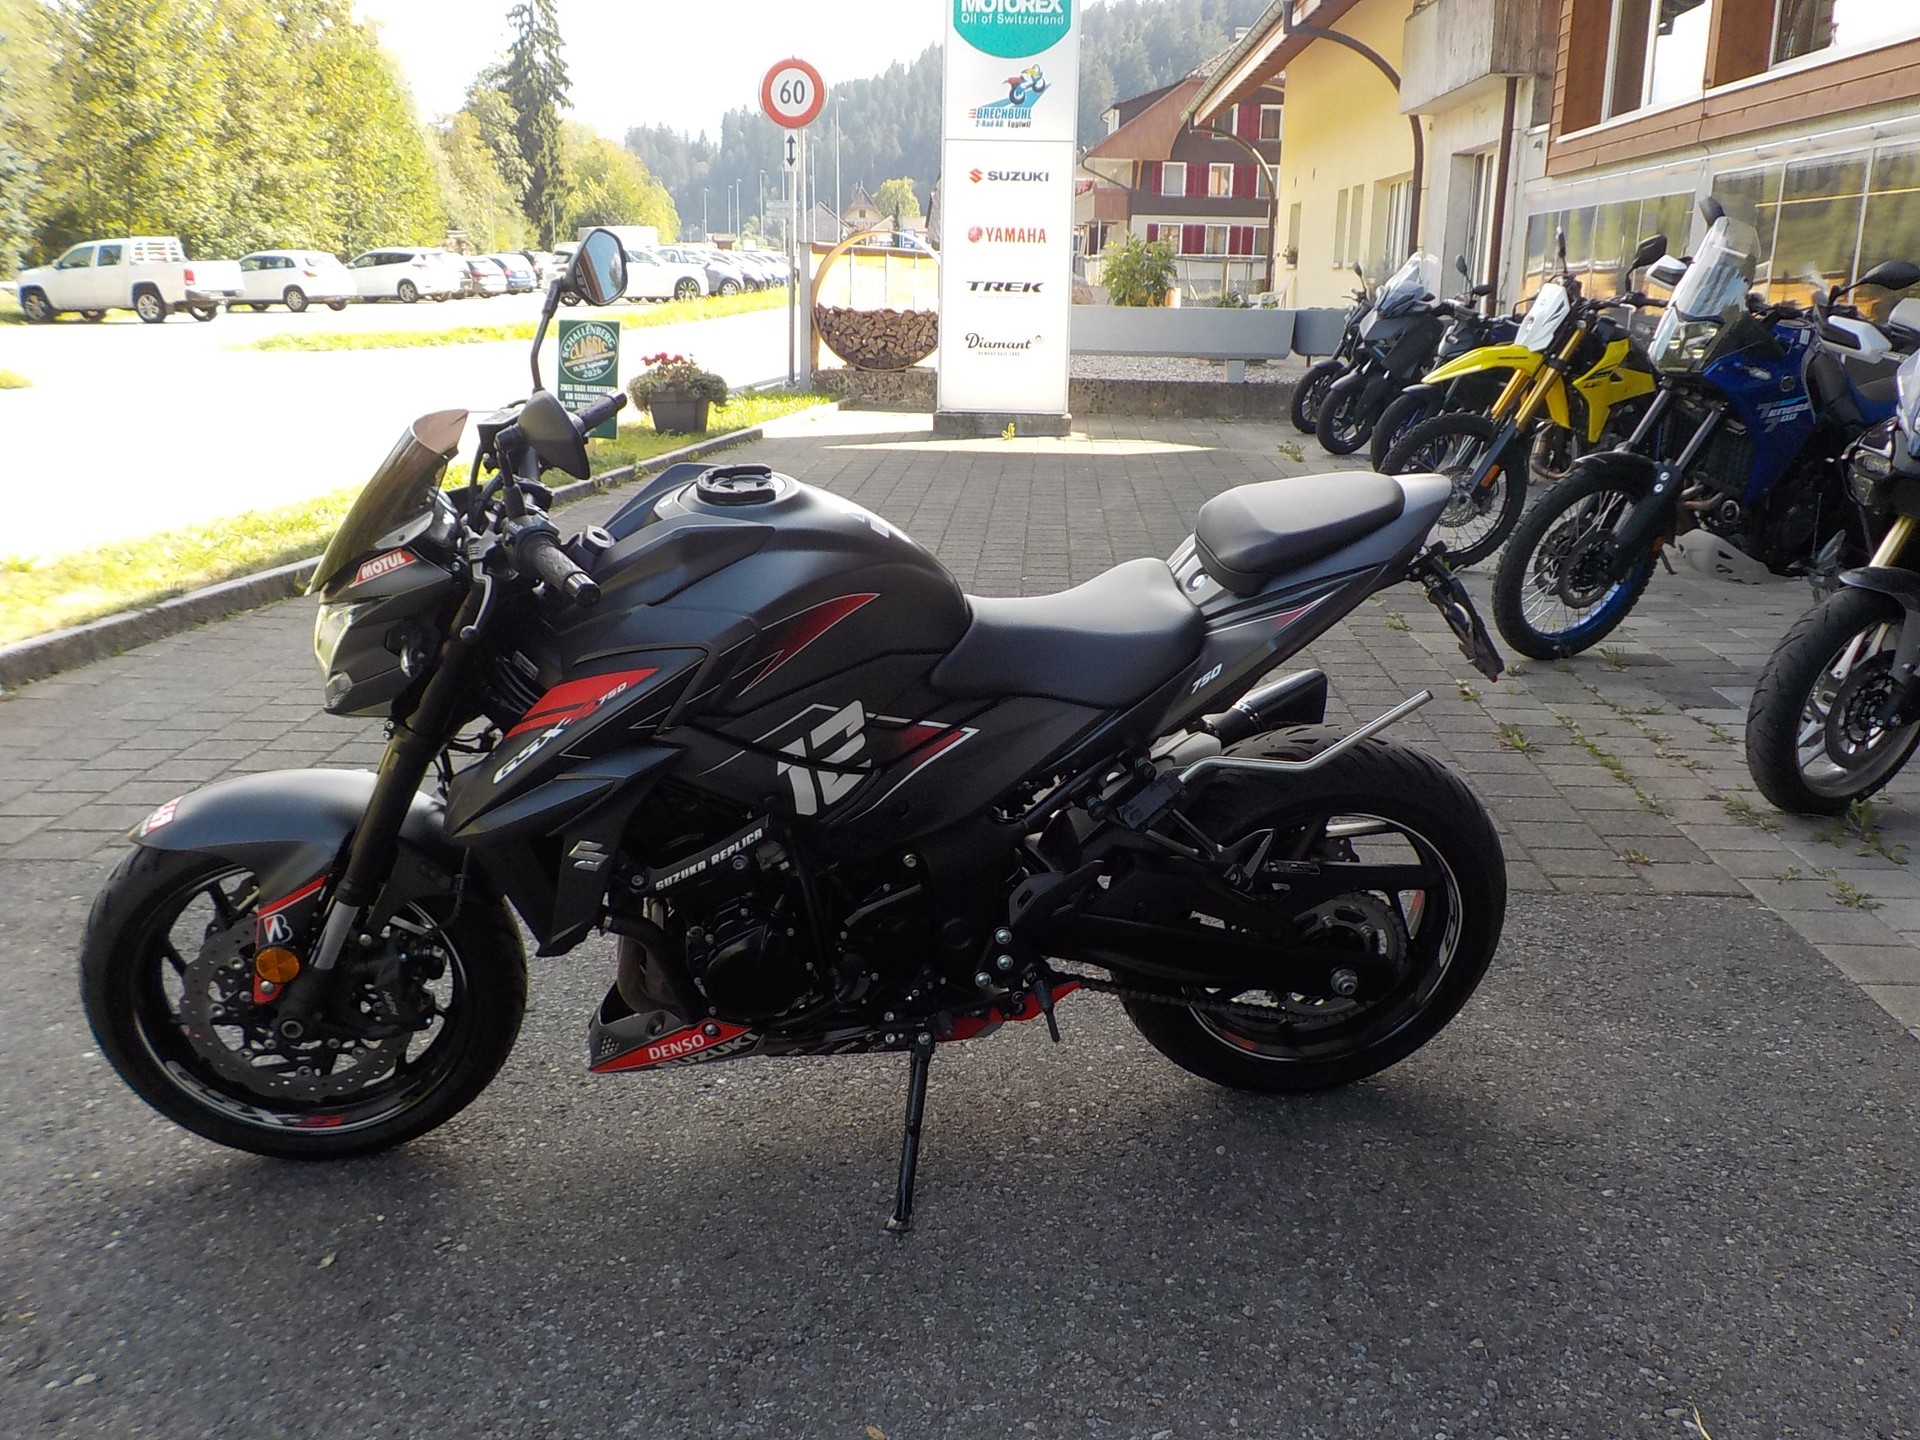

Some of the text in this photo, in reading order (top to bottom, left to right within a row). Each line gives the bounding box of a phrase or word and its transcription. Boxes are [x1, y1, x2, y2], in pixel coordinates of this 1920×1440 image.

[961, 13, 1064, 25] Oil of Switzerland
[780, 79, 805, 104] 60
[987, 171, 1049, 182] SUZUKI
[986, 227, 1047, 243] YAMAHA
[966, 281, 1045, 293] TREK
[562, 323, 616, 358] SCHALLENBERG
[570, 335, 608, 359] CLASSIC
[965, 332, 1032, 349] Diamant
[582, 366, 602, 378] 2026
[361, 552, 406, 580] MOTUL
[1191, 663, 1223, 695] 750
[598, 682, 628, 705] 750
[655, 828, 763, 891] SUZUKA REPLICA
[648, 1033, 705, 1060] DENSO
